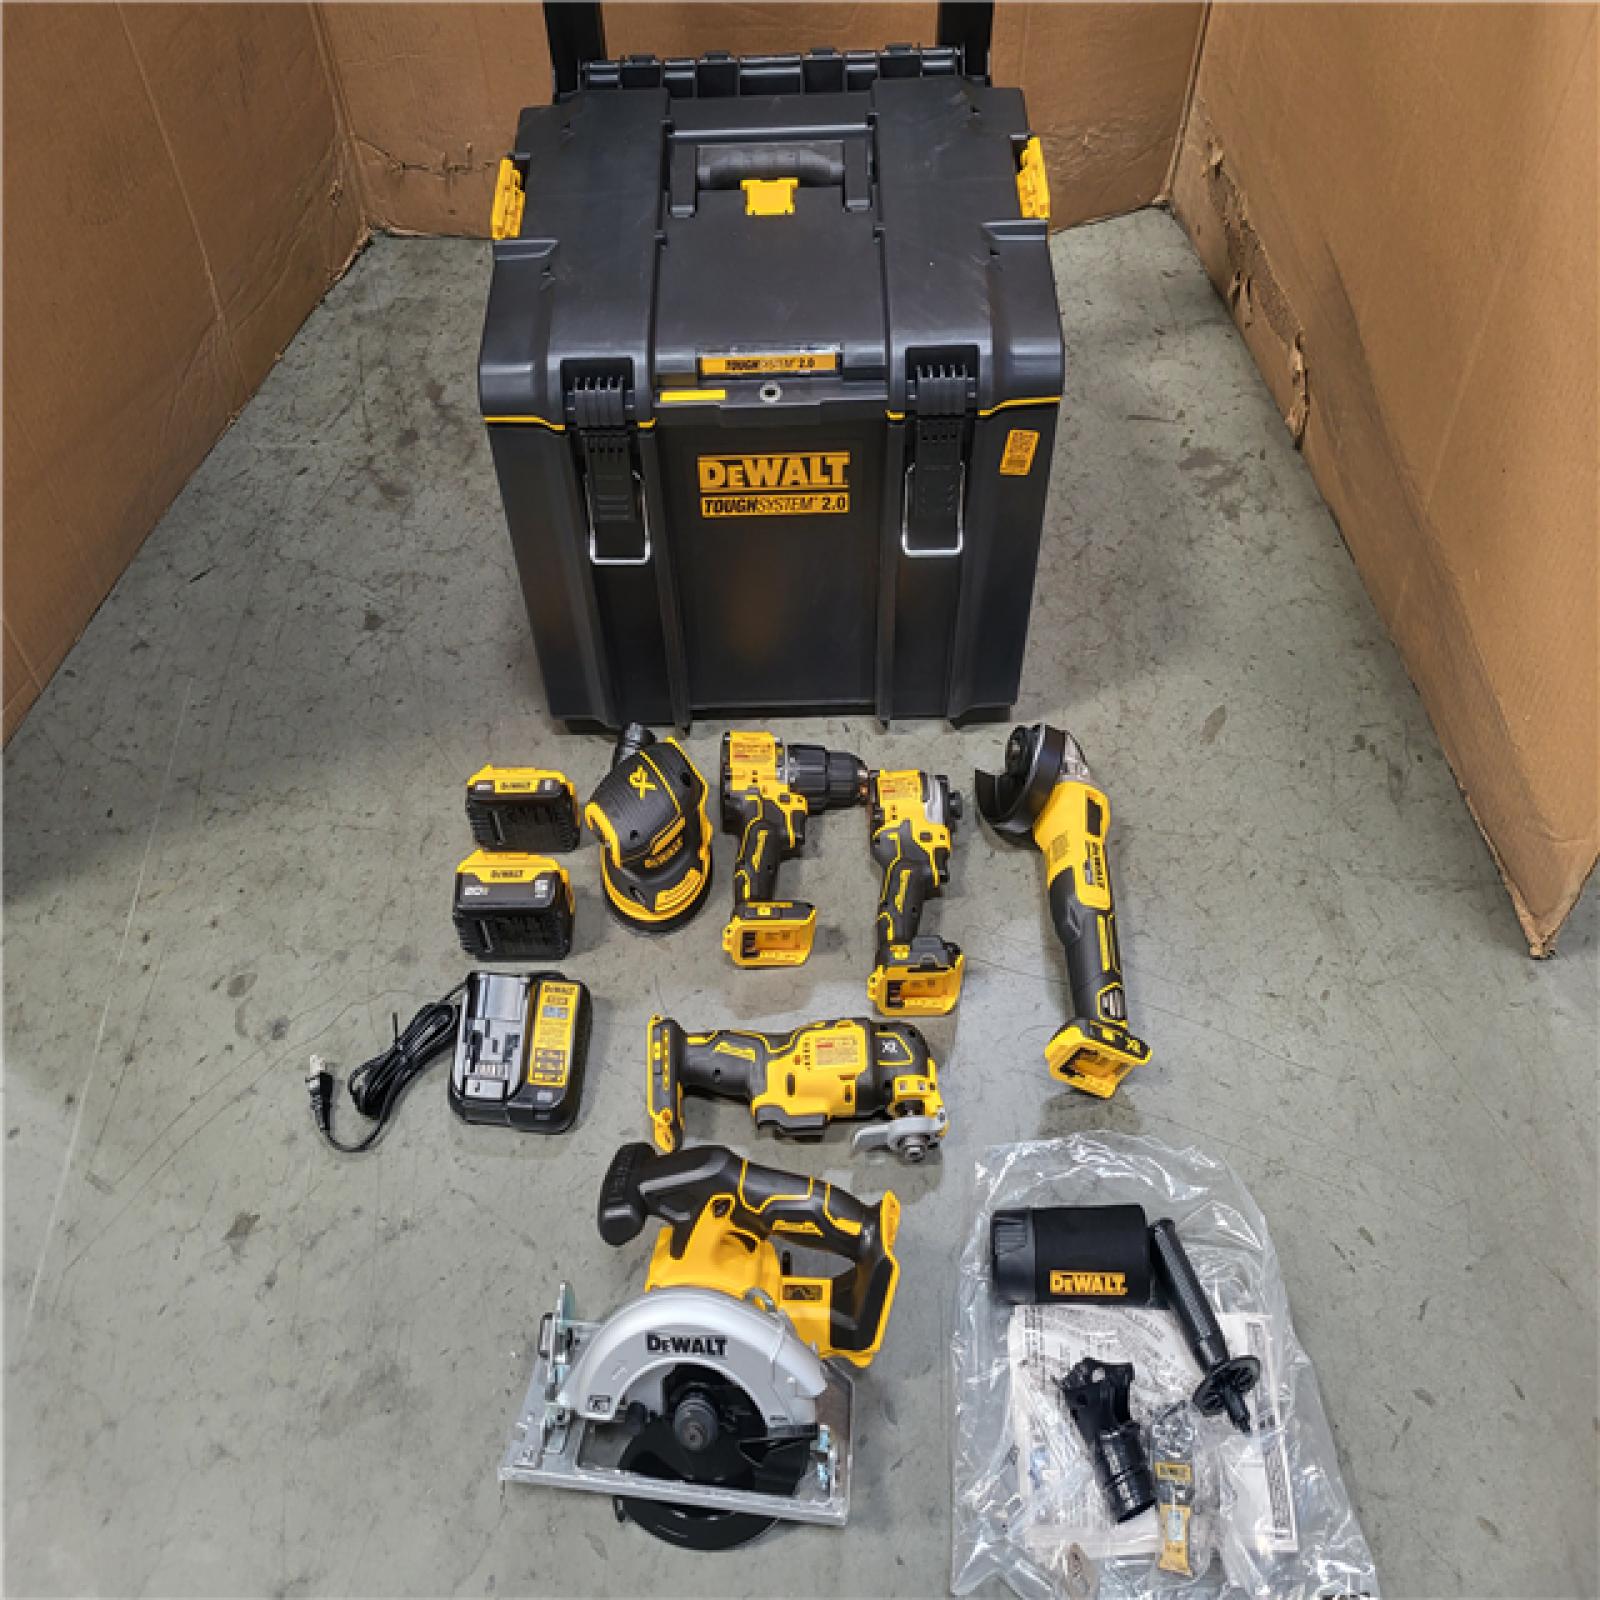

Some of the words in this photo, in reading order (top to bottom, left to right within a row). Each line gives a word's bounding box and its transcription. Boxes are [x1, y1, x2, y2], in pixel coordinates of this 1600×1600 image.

[698, 452, 849, 492] DEWALT
[821, 496, 846, 511] 2.0
[1050, 1269, 1128, 1296] DEWALT
[647, 1333, 729, 1358] DEWALT
